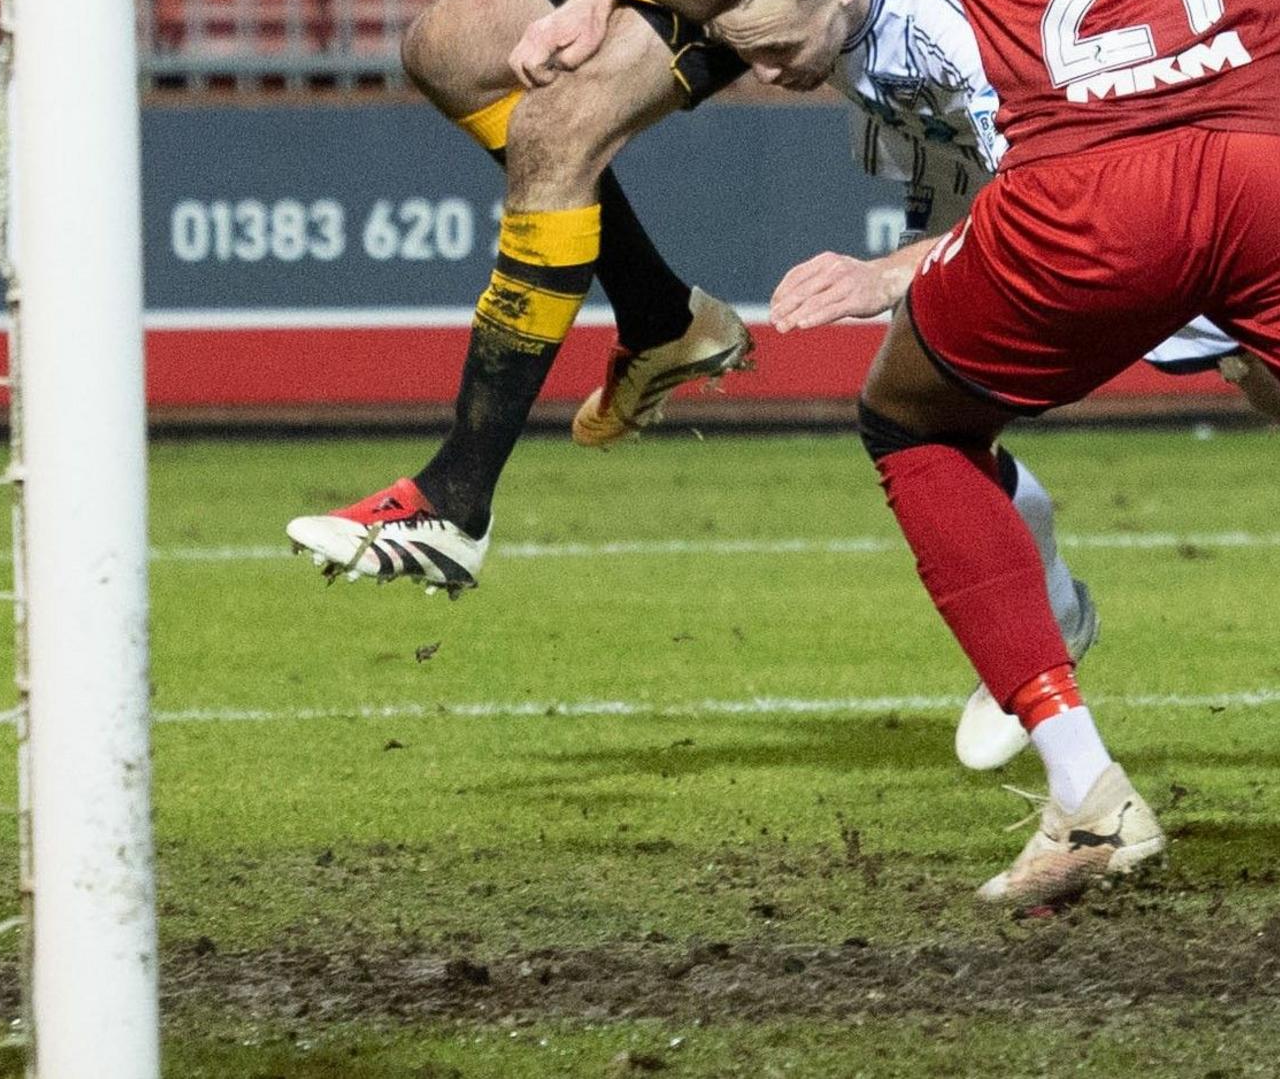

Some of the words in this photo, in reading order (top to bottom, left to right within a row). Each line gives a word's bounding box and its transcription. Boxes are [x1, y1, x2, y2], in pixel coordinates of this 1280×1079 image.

[1066, 31, 1252, 103] MKM
[170, 197, 347, 262] 01383
[362, 196, 473, 262] 620
